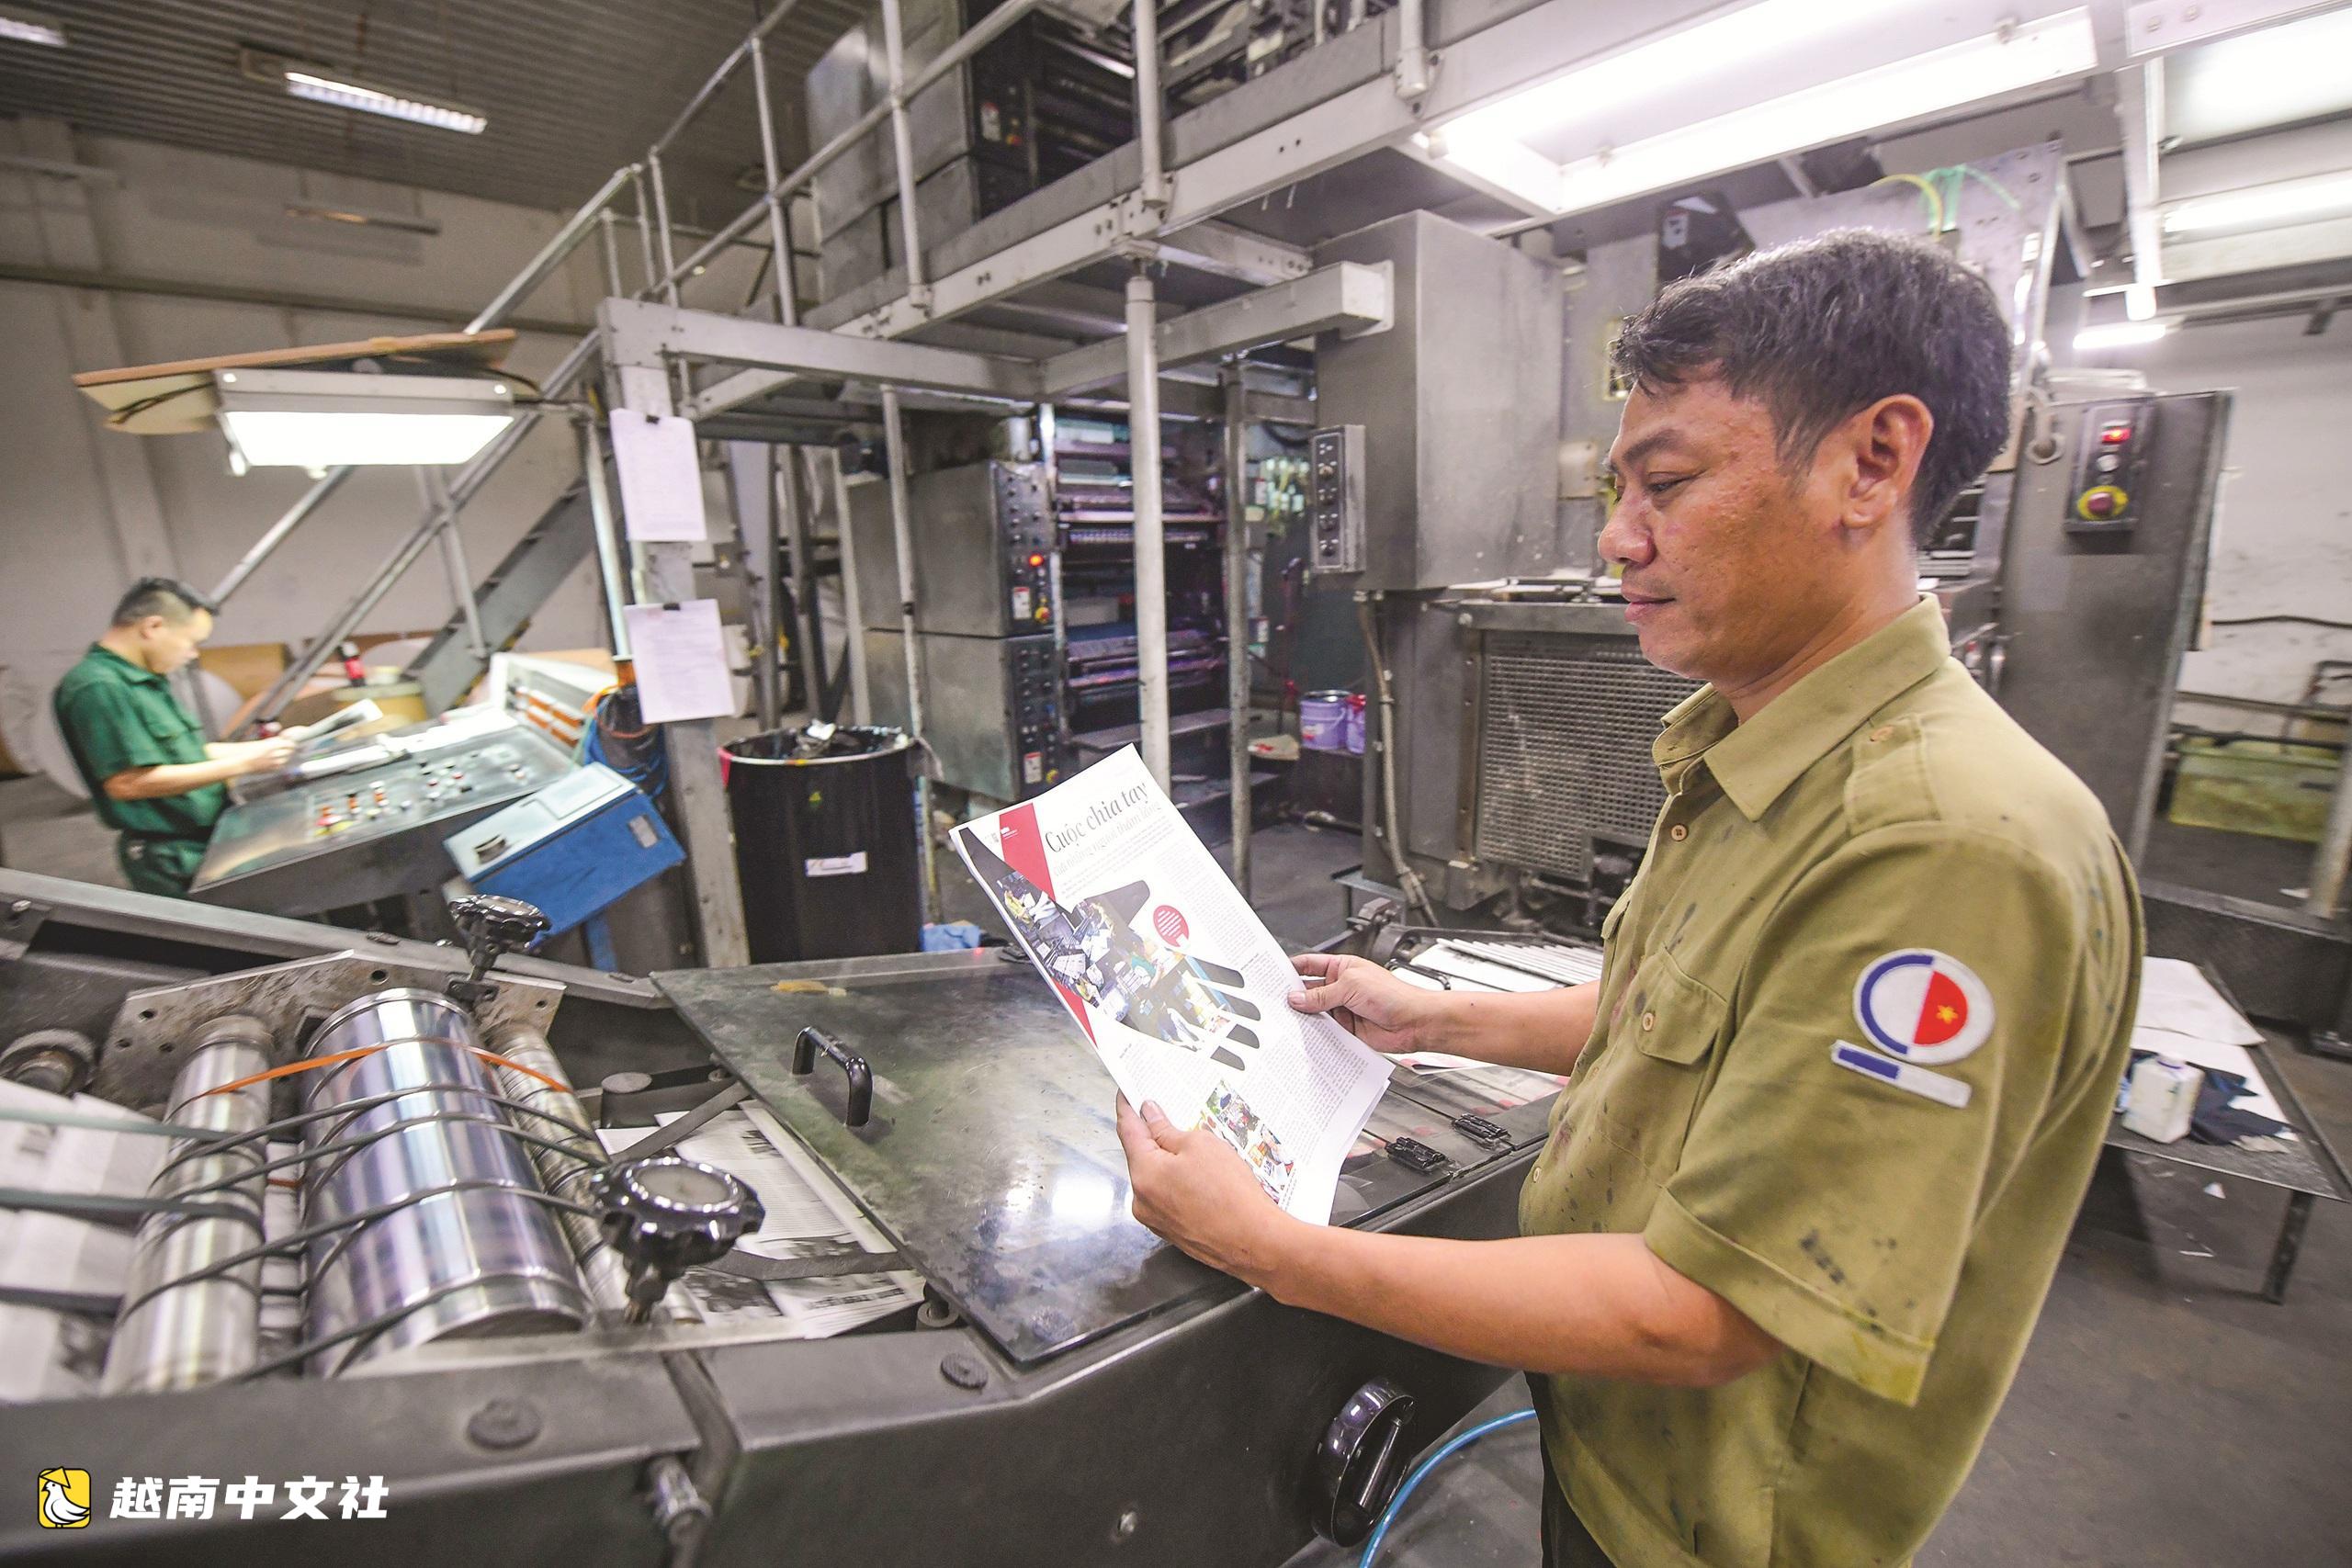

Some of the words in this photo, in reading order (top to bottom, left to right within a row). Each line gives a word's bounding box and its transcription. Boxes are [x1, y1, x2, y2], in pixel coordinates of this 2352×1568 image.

[1045, 823, 1086, 853] Cuộc
[1086, 799, 1123, 830] chia
[1122, 781, 1149, 807] tay
